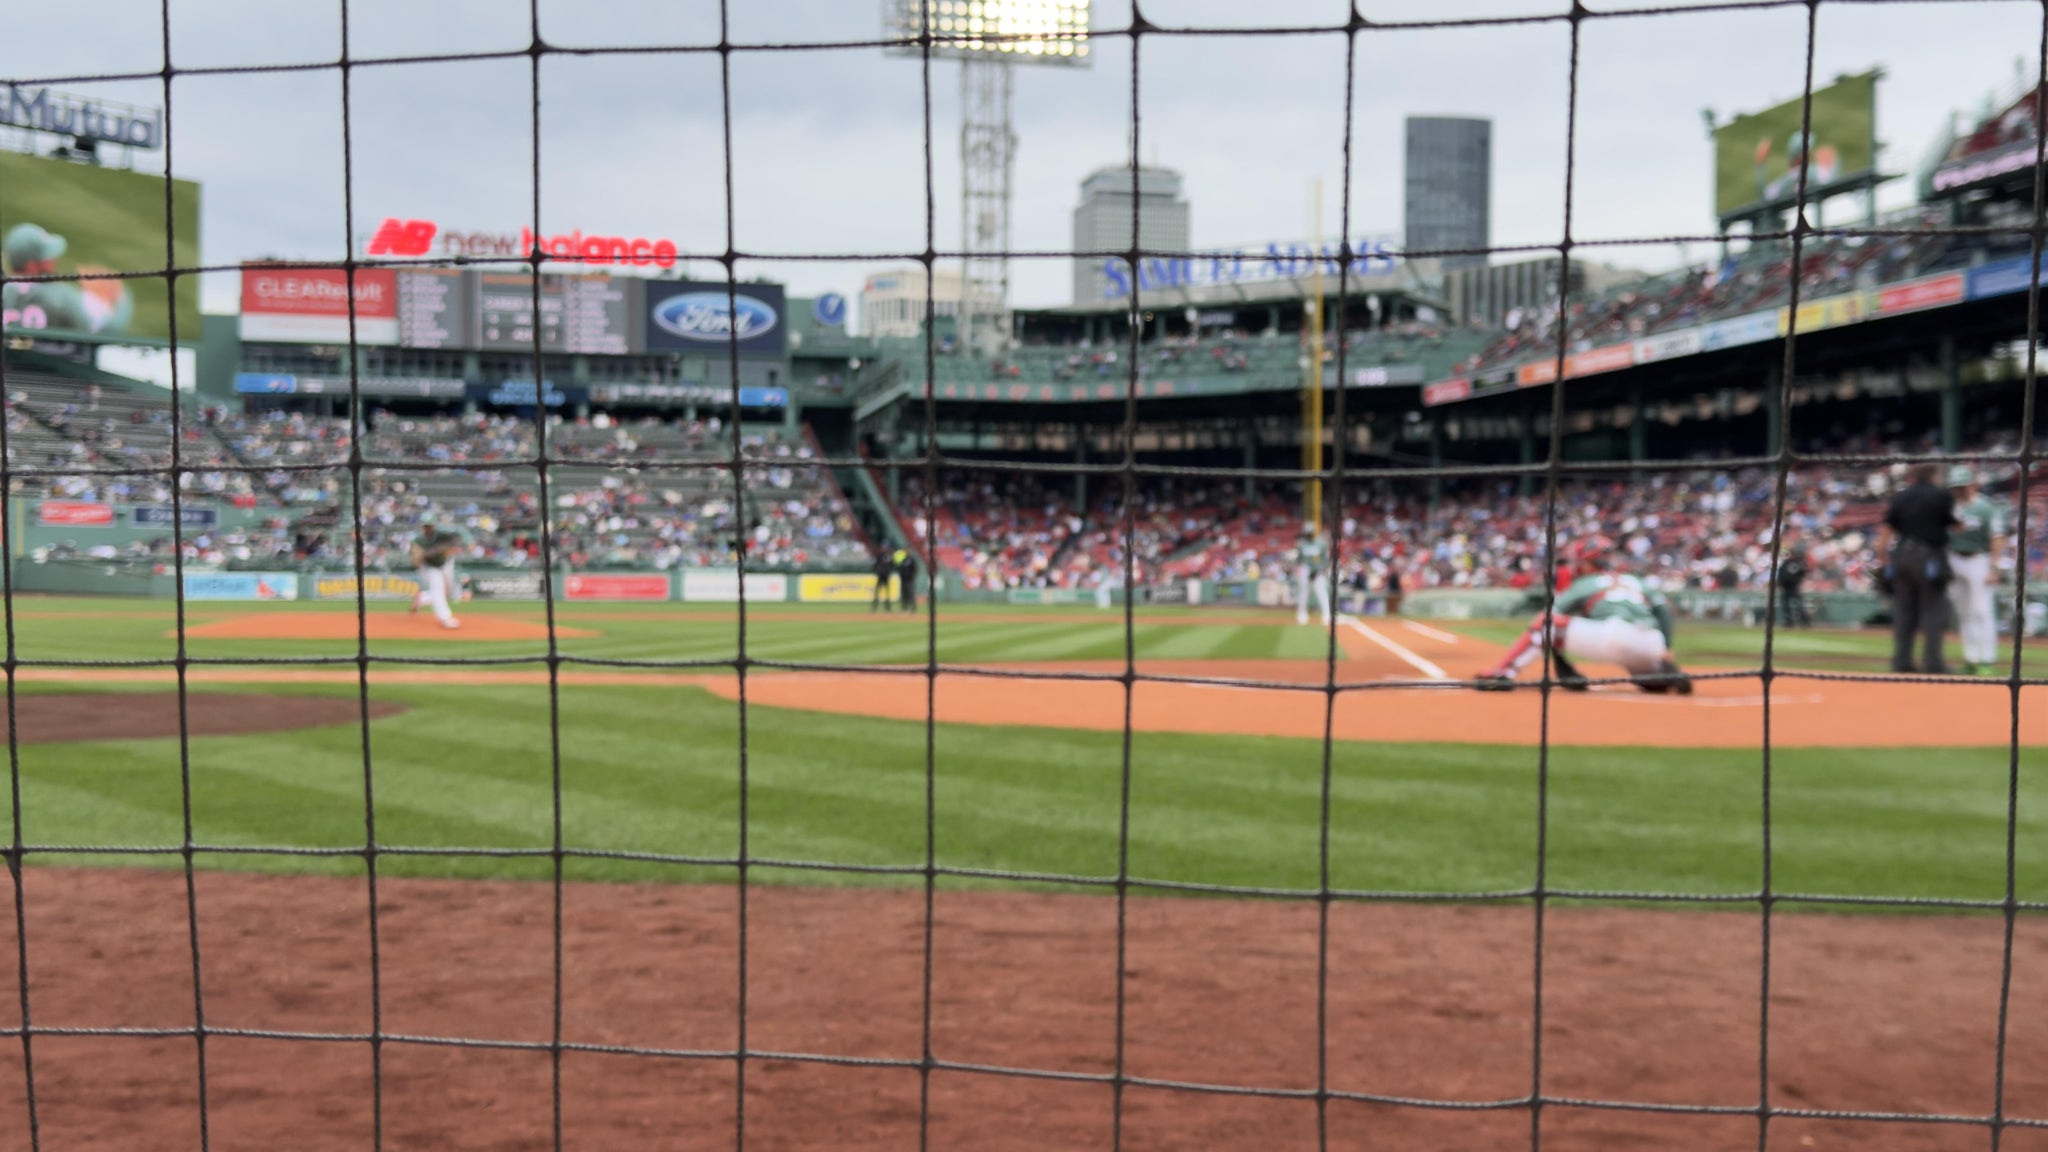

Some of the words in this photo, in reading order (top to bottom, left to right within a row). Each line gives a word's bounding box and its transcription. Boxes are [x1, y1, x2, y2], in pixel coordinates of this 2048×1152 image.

[444, 229, 517, 255] new
[521, 225, 678, 268] balance
[677, 303, 752, 333] Ford
